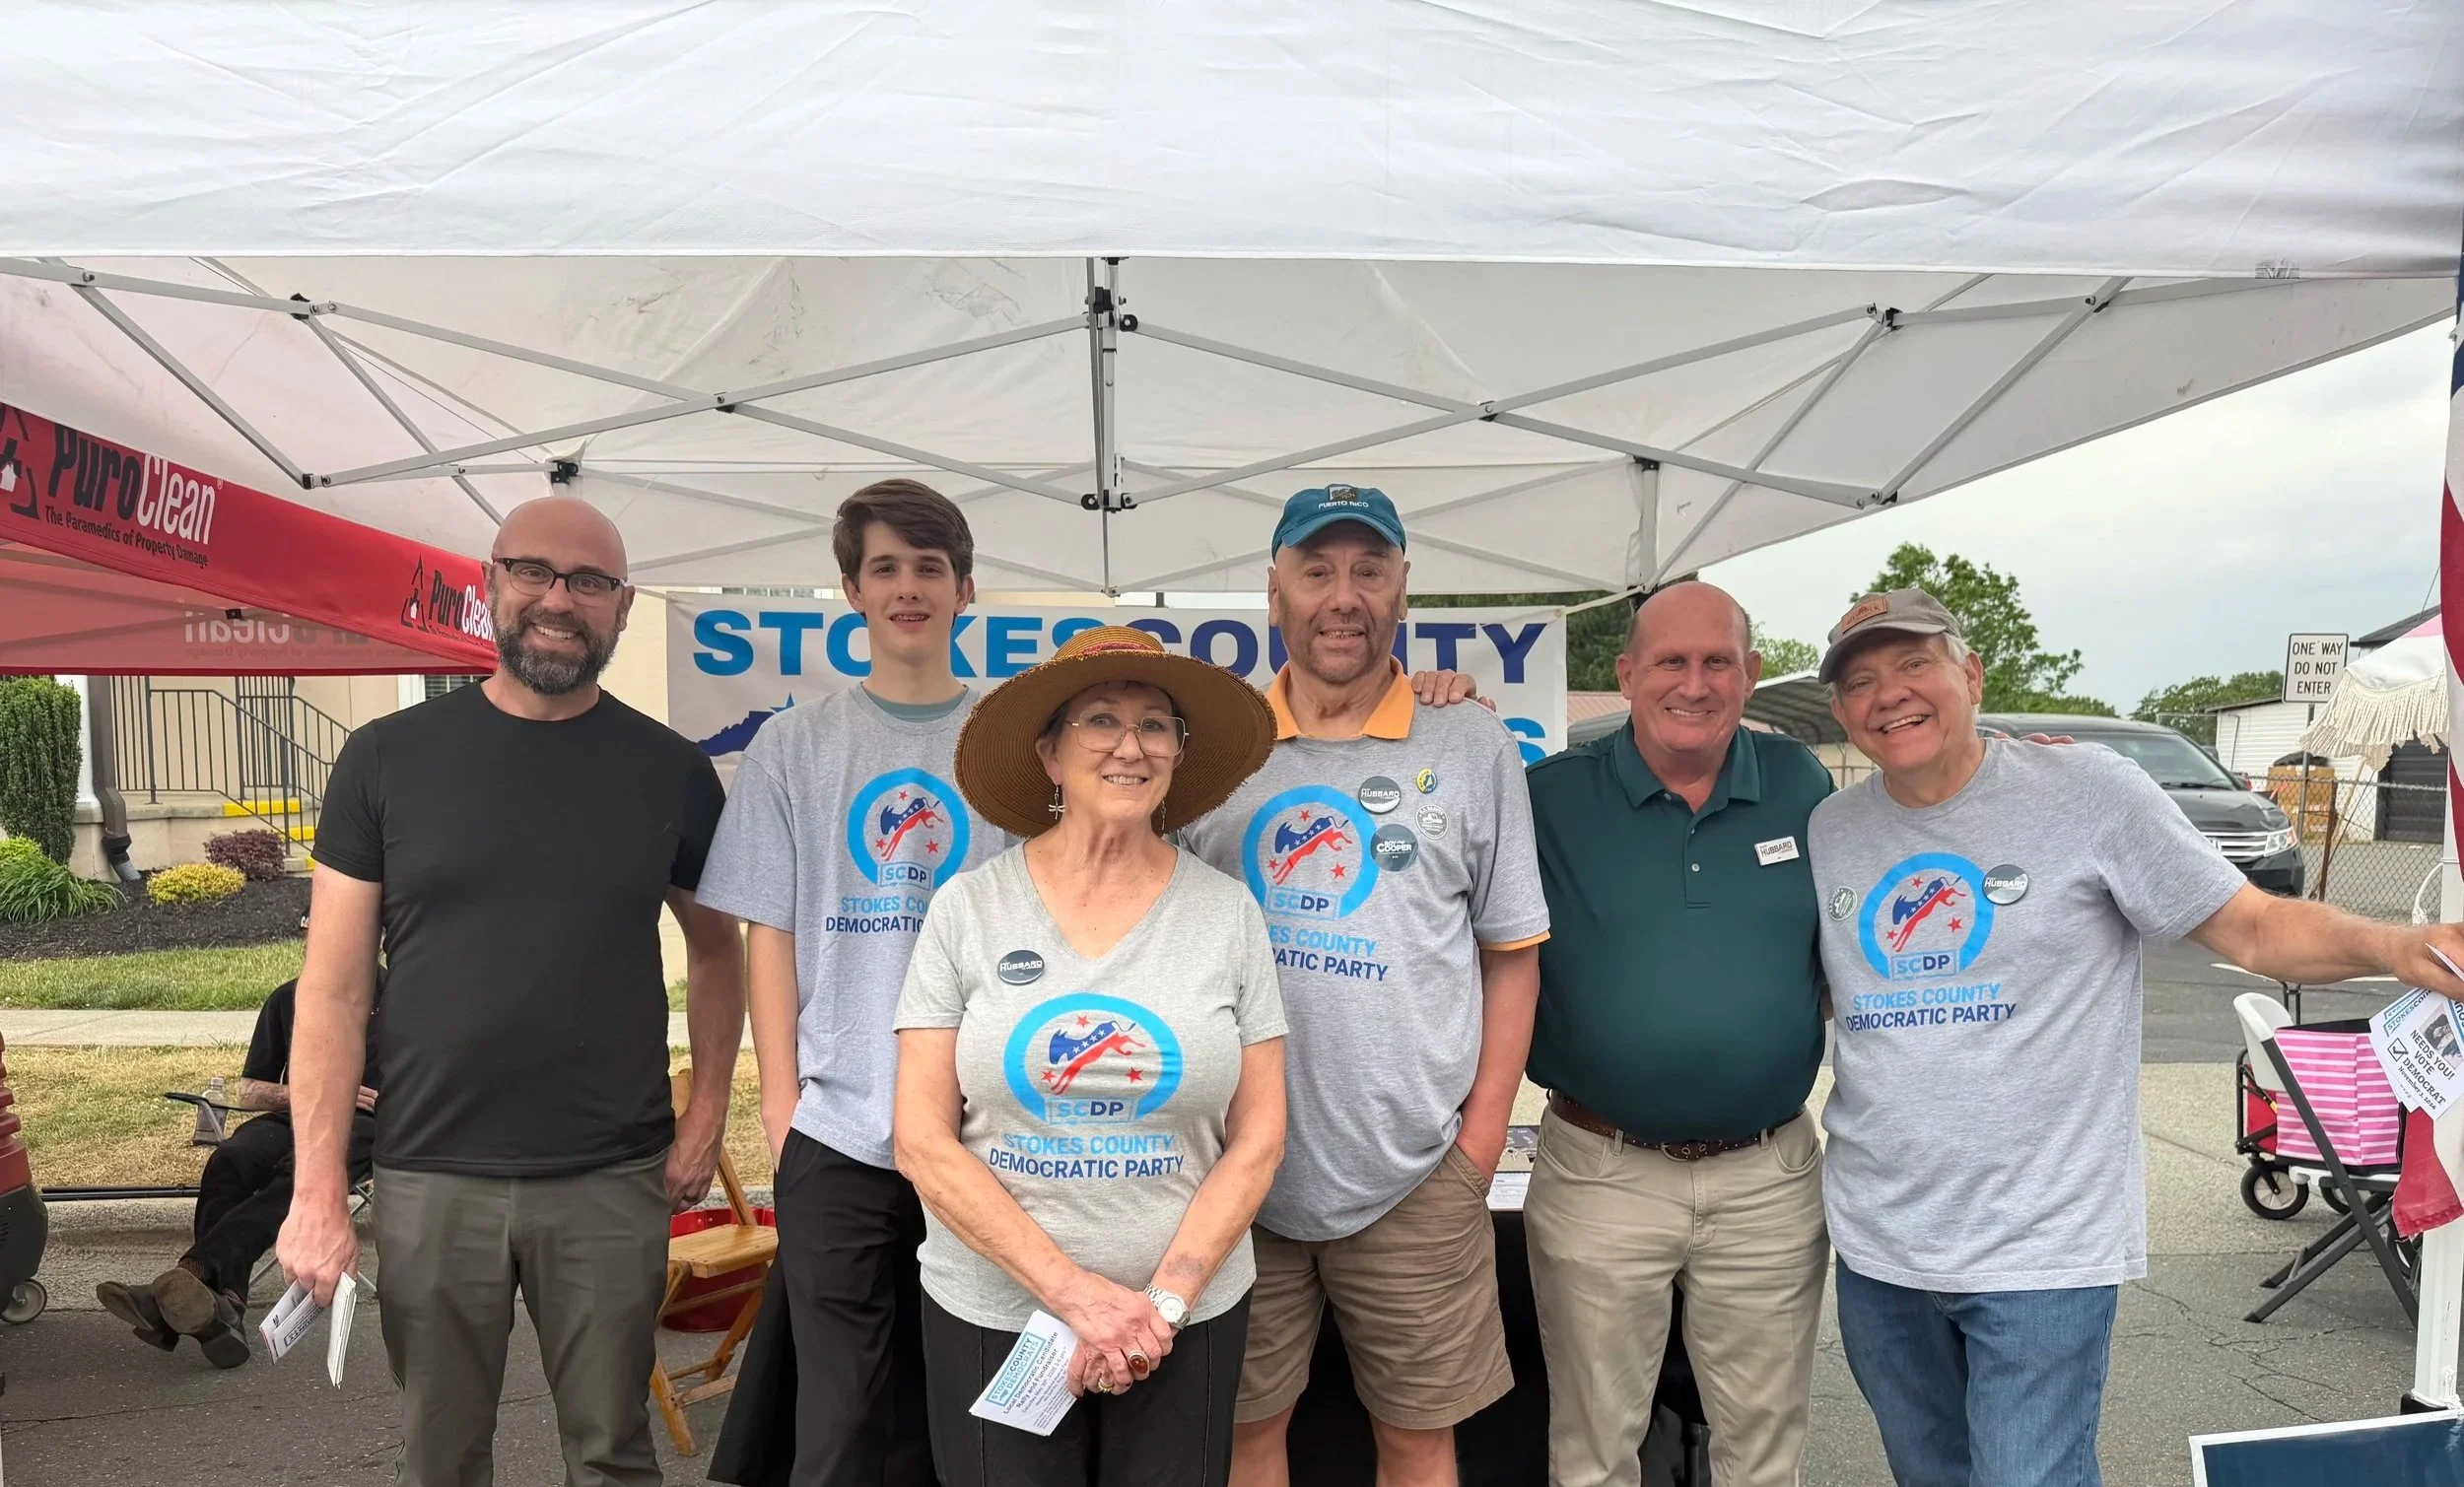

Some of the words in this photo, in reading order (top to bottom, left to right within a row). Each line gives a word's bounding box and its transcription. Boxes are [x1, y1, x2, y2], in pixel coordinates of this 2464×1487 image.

[1318, 501, 1348, 509] PUERTO
[45, 506, 63, 526] The
[66, 512, 120, 542] Paramedics
[123, 529, 134, 545] of
[136, 533, 175, 561] Property
[176, 544, 209, 569] Damage
[2292, 642, 2315, 655] ONE
[2321, 642, 2344, 655] WAY
[2294, 661, 2310, 675] DO
[2315, 661, 2338, 675] NOT
[2296, 681, 2331, 694] ENTER
[1376, 843, 1412, 853] COOPER
[885, 866, 927, 883] SCDP
[842, 895, 901, 914] STOKES
[1274, 892, 1330, 912] SCDP
[1296, 928, 1377, 957] COUNTY
[1323, 956, 1389, 981] PARTY
[1896, 953, 1951, 975] SCDP
[1853, 989, 1918, 1010] STOKES
[1922, 982, 2002, 1005] COUNTY
[1845, 1007, 1948, 1032] DEMOCRATIC
[1951, 1003, 2018, 1024] PARTY
[2410, 1030, 2435, 1059] NEEDS
[2433, 1056, 2455, 1080] YOU!
[2414, 1050, 2435, 1075] VOTE
[2398, 1066, 2422, 1094] November
[2403, 1057, 2446, 1105] DEMOCRAT
[1057, 1100, 1125, 1117] SCDP
[1003, 1132, 1082, 1155] STOKES
[1090, 1133, 1175, 1155] COUNTY
[989, 1147, 1119, 1179] DEMOCRATIC
[1125, 1154, 1185, 1179] PARTY
[1003, 1398, 1017, 1415] Local
[1014, 1365, 1040, 1399] Democratic
[1036, 1331, 1059, 1365] Candidate
[1006, 1340, 1039, 1389] DEMOCRATS
[1016, 1393, 1030, 1408] Rally
[1027, 1382, 1037, 1393] and
[1034, 1348, 1059, 1383] Fundraiser
